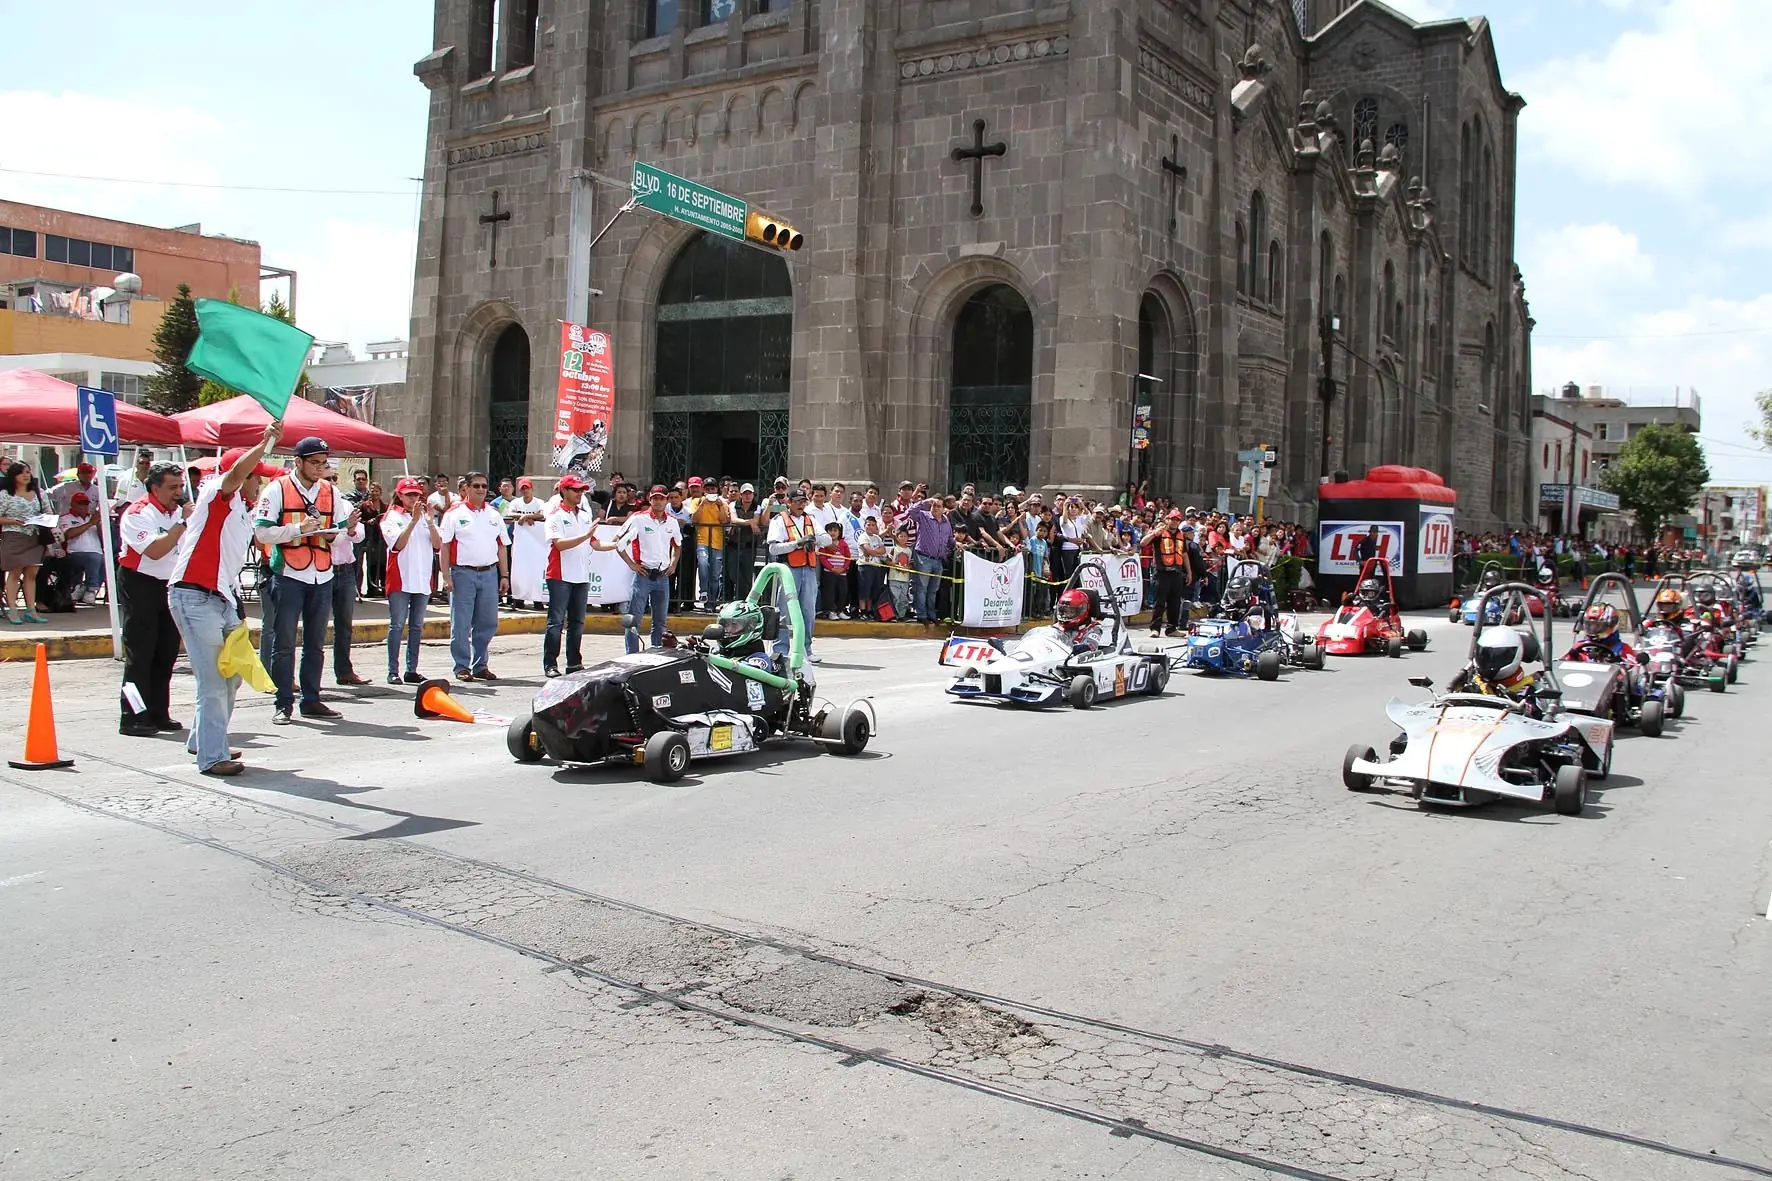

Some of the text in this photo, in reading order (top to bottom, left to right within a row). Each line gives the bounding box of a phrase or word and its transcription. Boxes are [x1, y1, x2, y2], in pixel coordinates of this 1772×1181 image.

[635, 170, 745, 224] BLVD. 16 DE SEPTIEMBRE
[680, 208, 720, 226] AYUNTAMIENTO
[563, 350, 583, 372] 12
[562, 371, 600, 383] octubre
[1423, 523, 1449, 555] LTH
[1121, 564, 1137, 579] LTH
[1084, 579, 1103, 588] TOYO
[983, 597, 1013, 607] Desarrollo
[983, 608, 998, 617] para
[953, 645, 994, 661] LTH
[1127, 661, 1151, 691] 10
